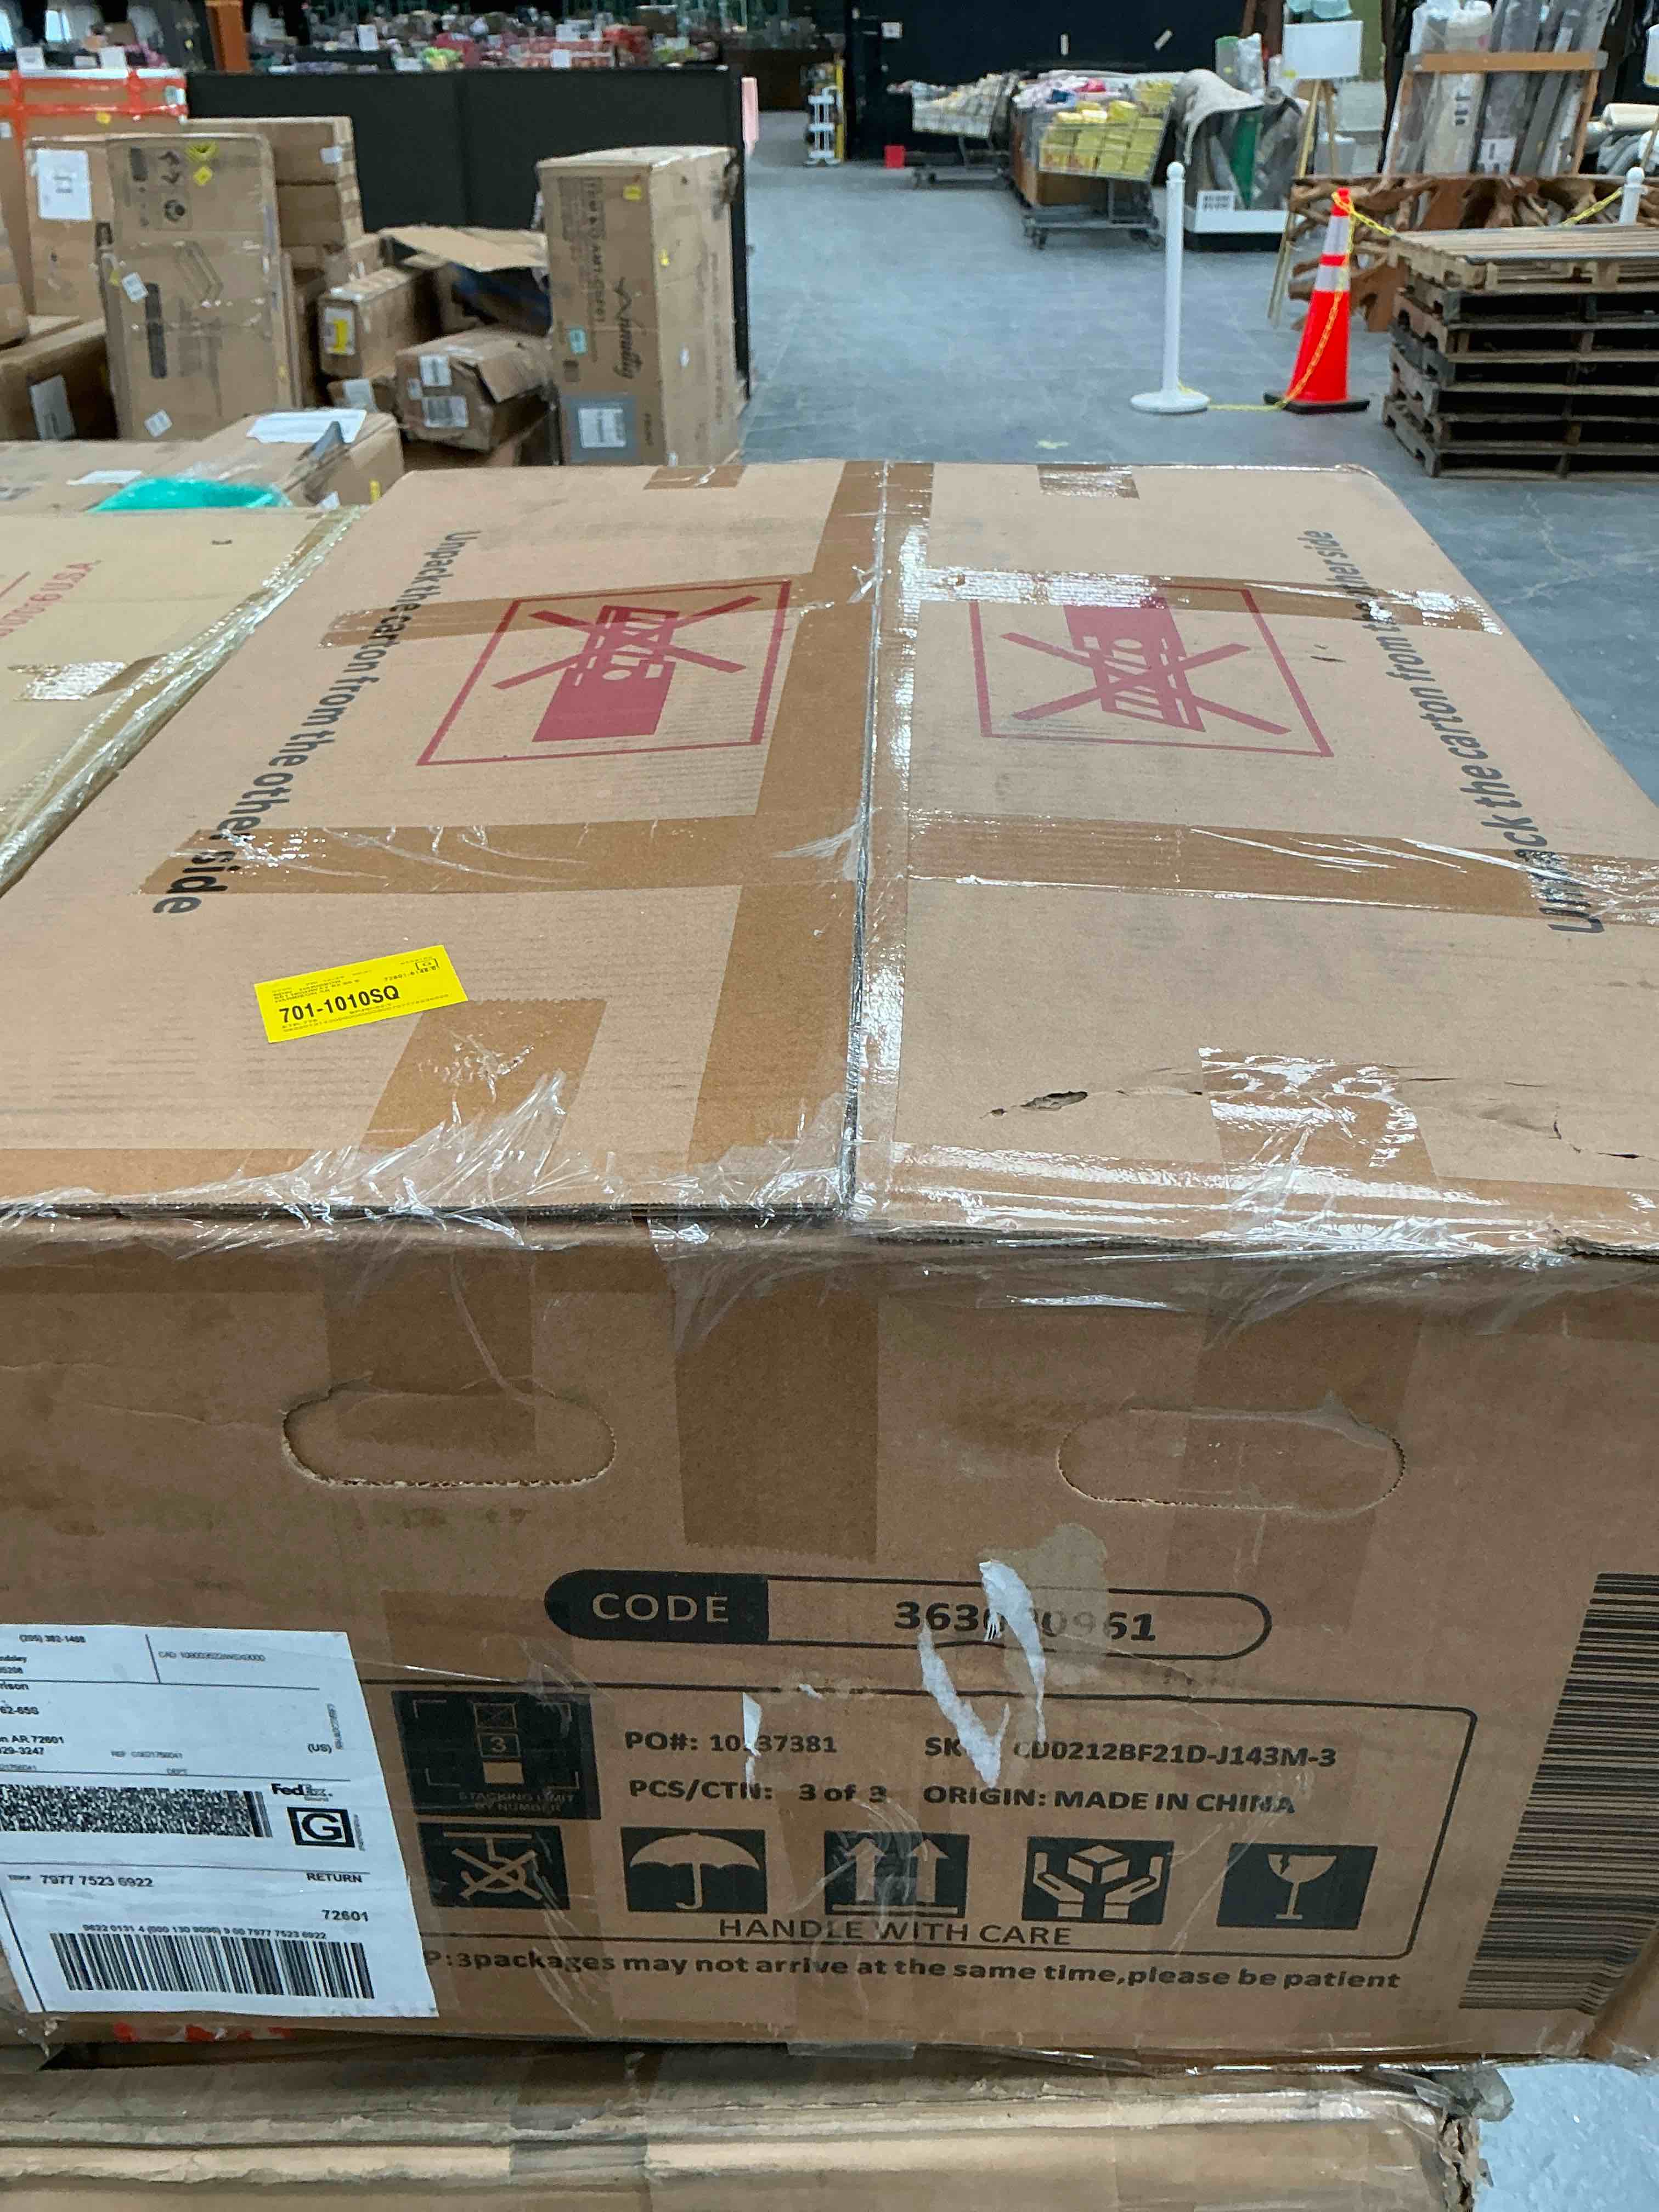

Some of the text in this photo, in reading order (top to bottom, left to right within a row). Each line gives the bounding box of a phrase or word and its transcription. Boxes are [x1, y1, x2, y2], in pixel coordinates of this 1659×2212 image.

[411, 529, 481, 584] Unpack
[1296, 531, 1348, 558] side
[389, 585, 441, 612] the
[344, 614, 412, 673] carton
[1375, 636, 1436, 681] from
[301, 676, 380, 726] from
[1409, 687, 1488, 759] carton
[268, 730, 336, 766] the
[1460, 765, 1522, 808] the
[153, 851, 241, 913] side
[279, 985, 400, 1023] 701-1010SQ
[592, 1593, 1156, 1641] CODE 3630961
[12, 1735, 30, 1743] AR
[308, 1743, 332, 1754] (US)
[489, 1737, 507, 1753] 3
[625, 1730, 698, 1752] PO#:
[709, 1734, 837, 1754] 1037381
[629, 1779, 1296, 1814] PCS/CTN: 3 of 3 ORIGIN: MADE IN CHINA
[302, 1813, 343, 1841] G
[78, 1875, 115, 1886] 7523
[306, 1872, 363, 1883] RETURN
[321, 1909, 369, 1922] 72601
[719, 1918, 1072, 1946] HANDLE WITH CARE
[623, 1956, 690, 1976] may
[696, 1955, 749, 1974] not
[756, 1957, 848, 1974] arrive
[857, 1959, 888, 1976] at
[894, 1957, 946, 1977] the
[953, 1962, 1037, 1980] same
[1238, 1967, 1277, 1987] be
[1283, 1970, 1402, 1990] patient
